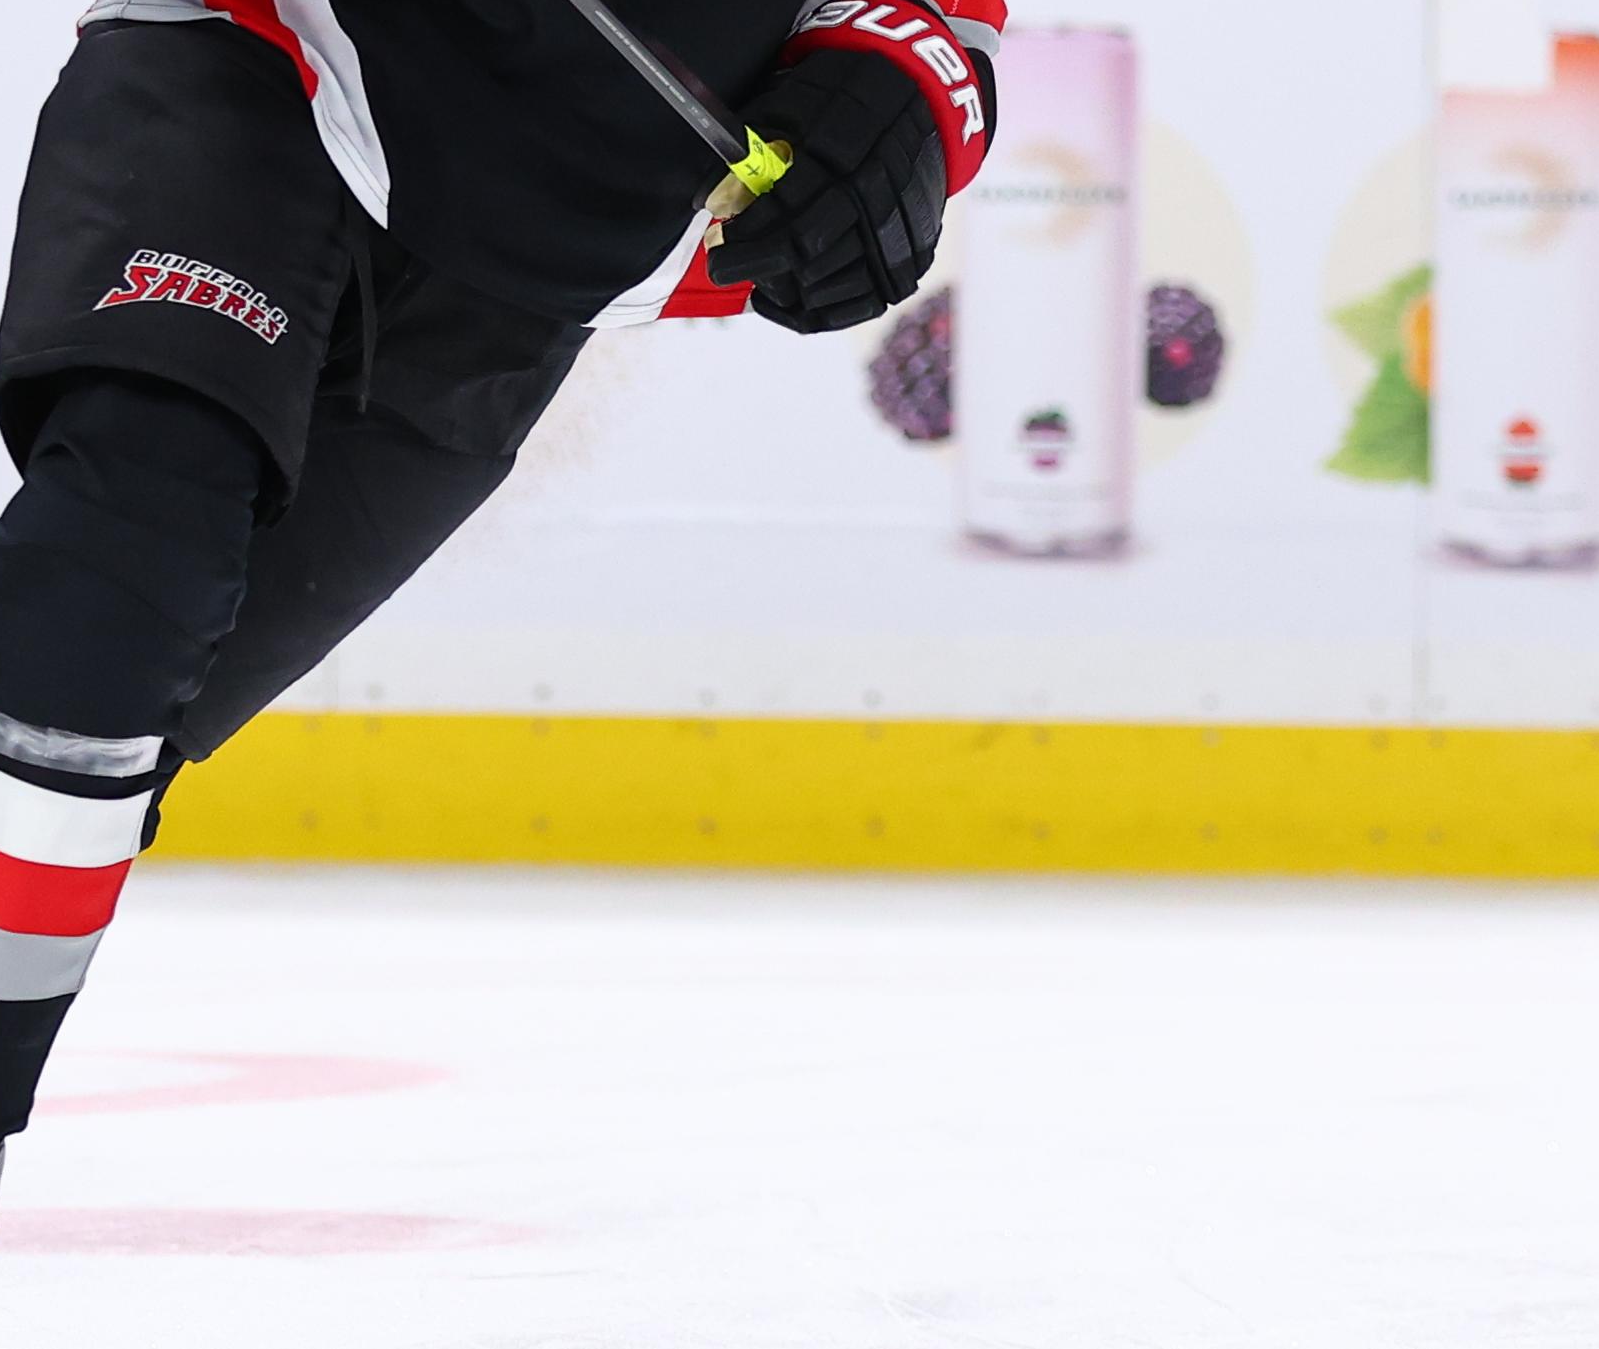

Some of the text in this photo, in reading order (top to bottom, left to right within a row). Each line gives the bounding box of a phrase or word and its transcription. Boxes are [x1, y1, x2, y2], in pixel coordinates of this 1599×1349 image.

[792, 0, 986, 146] AUER
[92, 263, 284, 346] SABRES
[126, 248, 289, 326] BUFFALO
